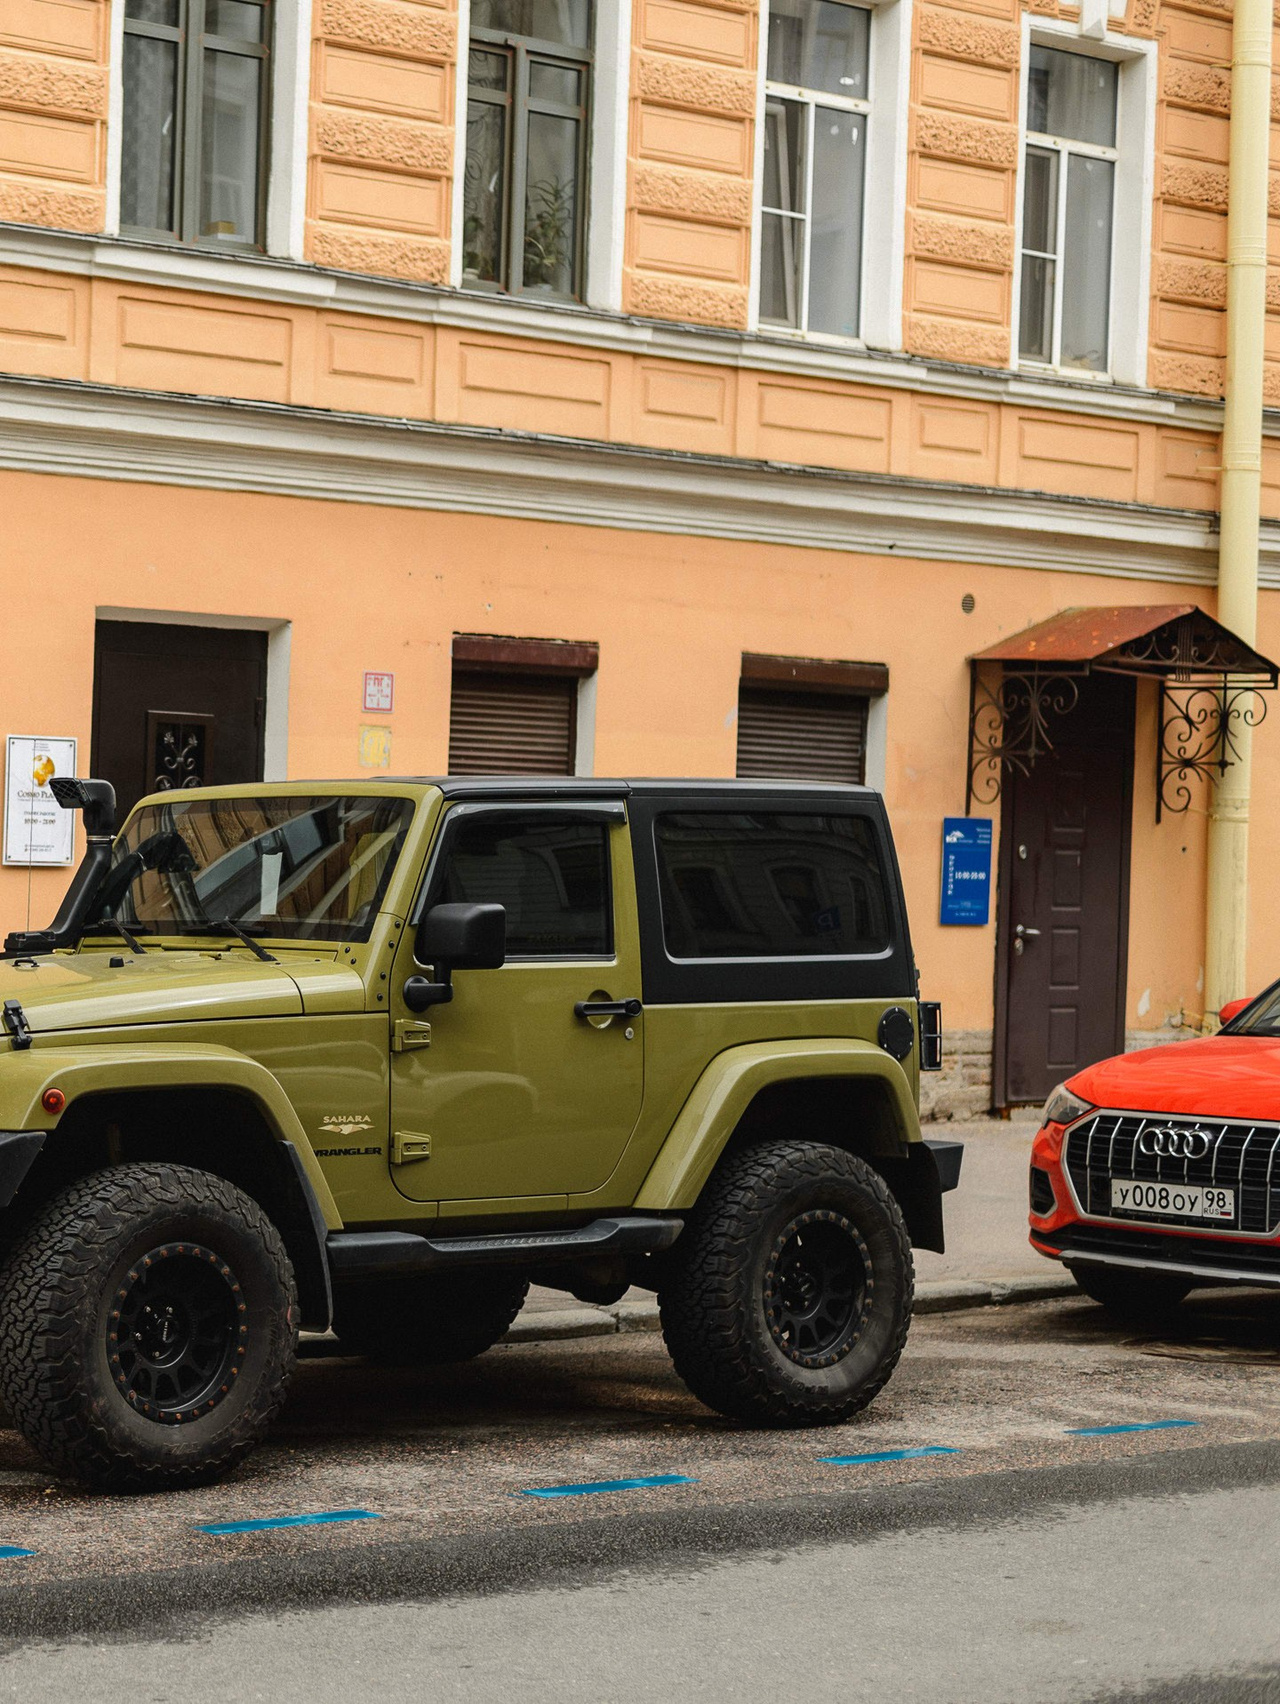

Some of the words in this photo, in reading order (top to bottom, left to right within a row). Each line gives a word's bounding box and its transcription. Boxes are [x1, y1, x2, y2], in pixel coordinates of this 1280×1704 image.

[323, 1115, 371, 1123] SAHARA
[1205, 1190, 1226, 1208] 98
[1204, 1207, 1220, 1216] RUS
